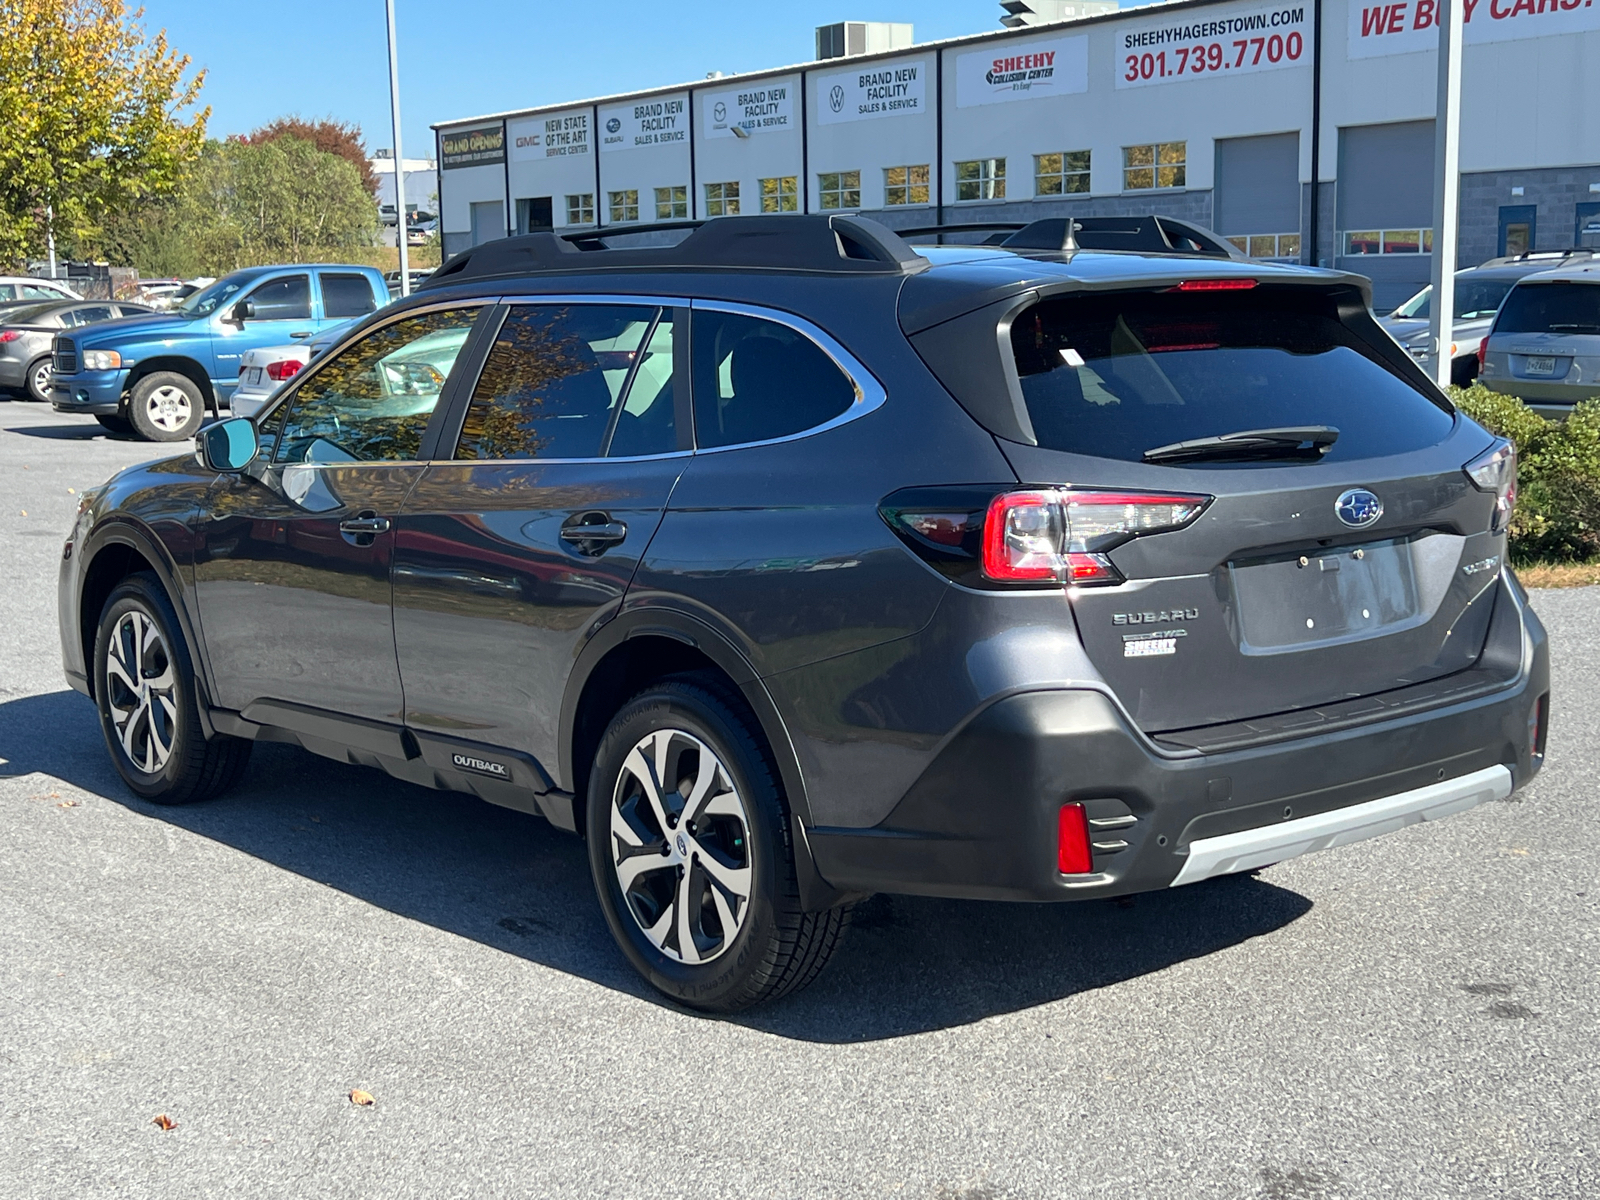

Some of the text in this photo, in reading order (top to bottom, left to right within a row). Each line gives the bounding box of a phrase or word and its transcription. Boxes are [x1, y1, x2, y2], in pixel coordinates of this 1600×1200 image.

[1361, 3, 1408, 37] WE
[1413, 0, 1478, 30] BY
[1125, 8, 1304, 48] SHEEHYHAGERSTOWN.COM
[992, 51, 1056, 74] SHEEHY
[1124, 31, 1303, 82] 301.739.7700
[859, 67, 917, 88] BRAND NEW
[993, 68, 1054, 85] COLLISION CENTER
[738, 88, 786, 106] BRAND NEW
[867, 83, 908, 100] FACILITY
[634, 100, 683, 119] BRAND NEW
[745, 102, 779, 118] FACILITY
[858, 98, 918, 114] SALES & SERVICE
[545, 115, 587, 133] NEW STATE
[641, 115, 676, 132] FACILITY
[763, 115, 787, 127] SERVICE
[443, 133, 503, 155] GRAND OPENING
[515, 134, 540, 148] GMC
[545, 129, 588, 147] OF THE ART
[634, 131, 685, 146] SALES & SERVICE
[546, 144, 588, 157] SERVICE CENTER
[1112, 608, 1199, 626] SUBARU
[1125, 638, 1177, 650] SHEEHY
[609, 700, 660, 739] YOKOHAMA
[454, 755, 506, 774] OUTBACK
